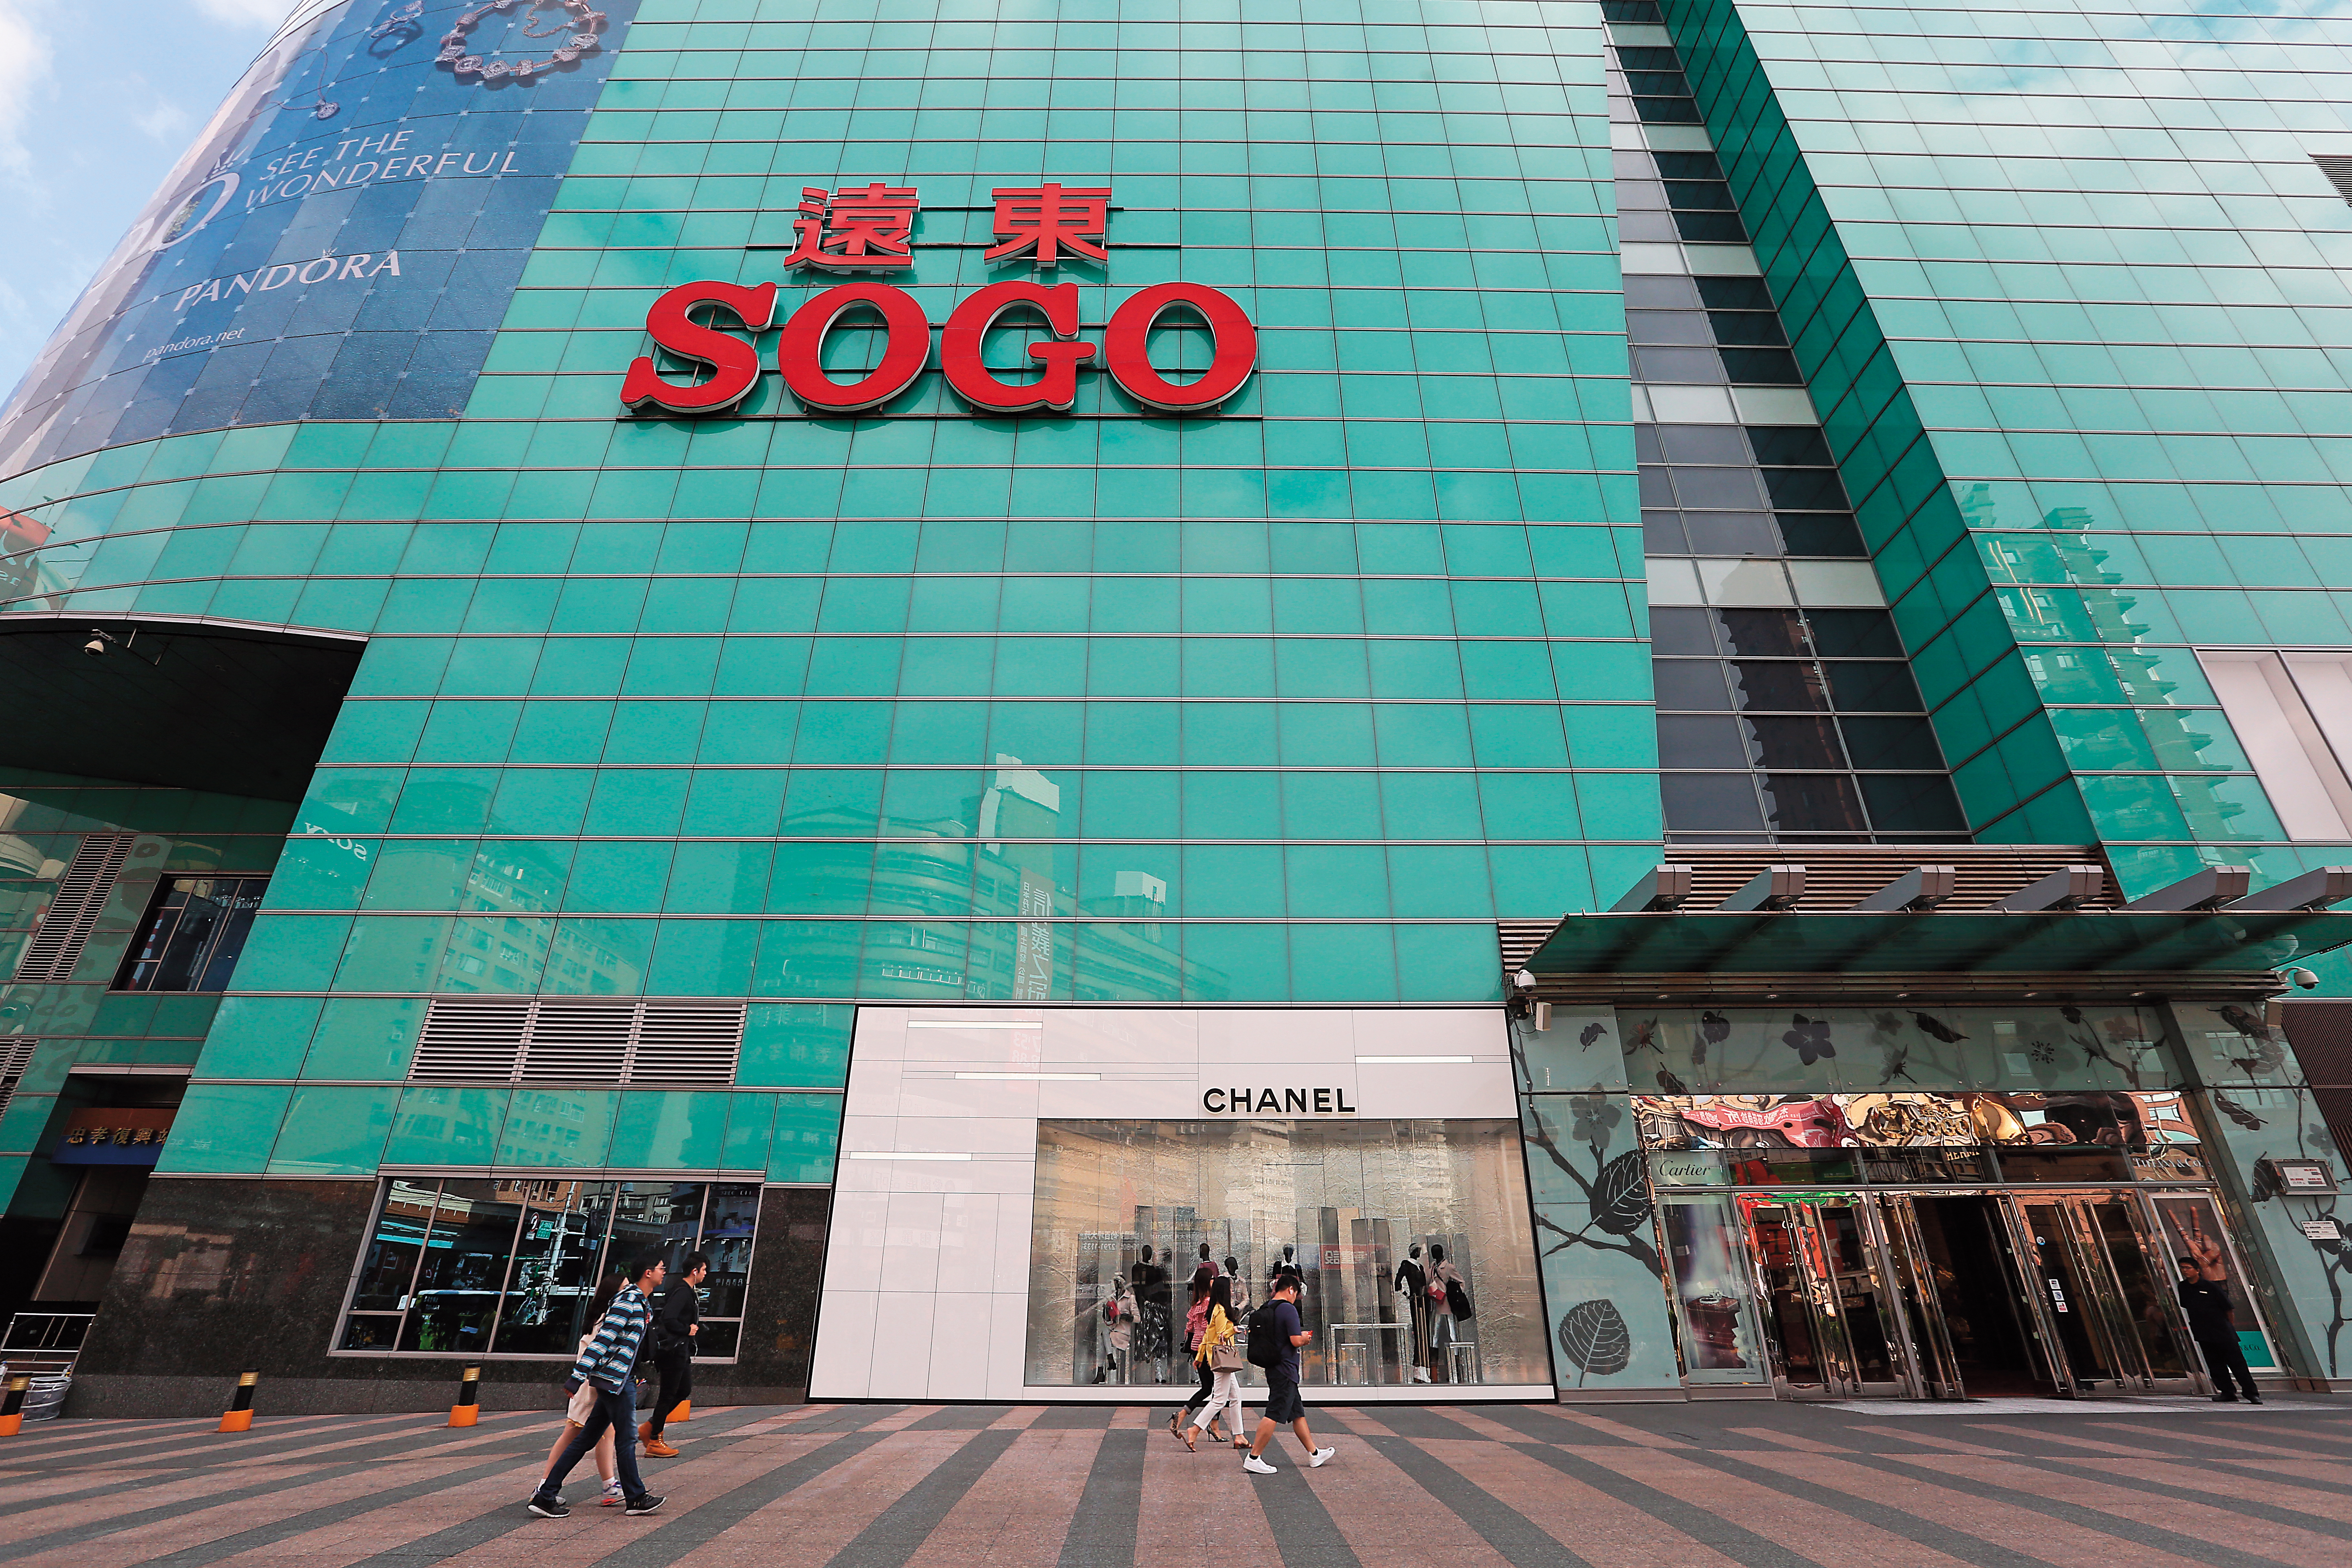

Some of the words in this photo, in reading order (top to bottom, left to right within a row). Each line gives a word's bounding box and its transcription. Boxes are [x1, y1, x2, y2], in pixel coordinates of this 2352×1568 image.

[260, 147, 324, 180] SEE
[336, 130, 416, 161] THE
[246, 152, 520, 209] WONDERFUL
[784, 182, 1113, 272] 遠東
[173, 249, 401, 312] PANDORA
[142, 327, 246, 363] pandora.net
[620, 280, 1258, 413] SOGO
[1203, 1087, 1356, 1114] CHANEL
[1910, 1118, 1970, 1136] SOGO
[1659, 1160, 1711, 1176] Cartier
